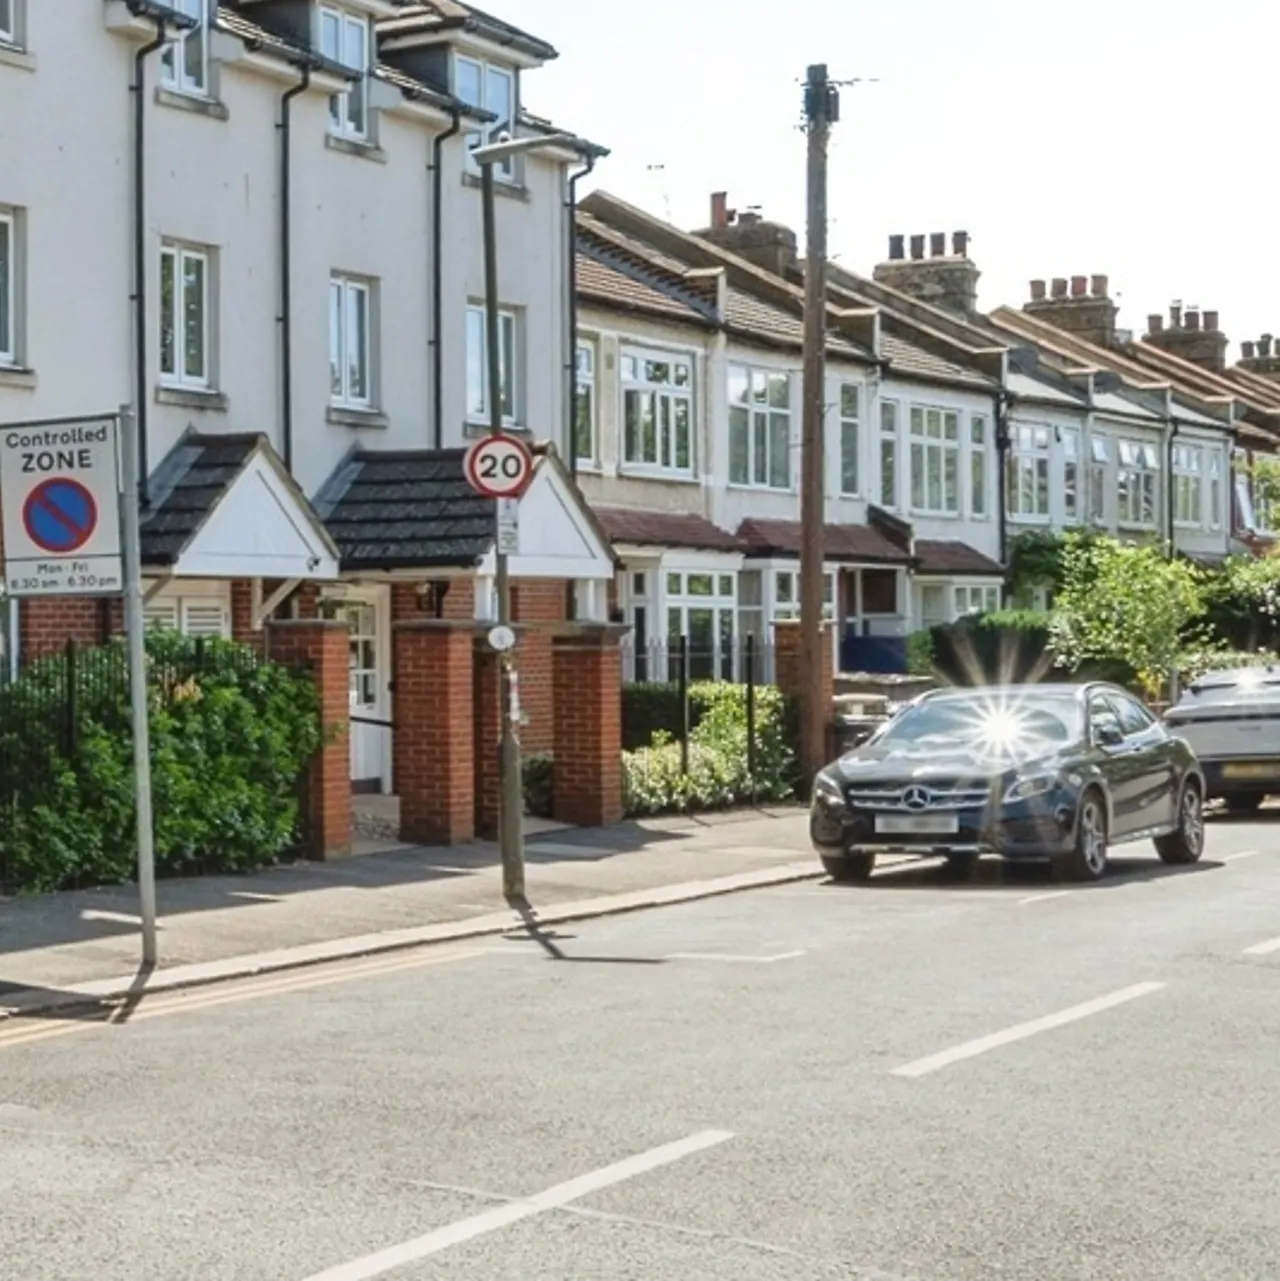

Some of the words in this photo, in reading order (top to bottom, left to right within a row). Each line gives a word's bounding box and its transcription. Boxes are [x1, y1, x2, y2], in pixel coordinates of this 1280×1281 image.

[5, 425, 108, 449] Controlled
[21, 448, 92, 473] ZONE
[479, 454, 522, 478] 20
[37, 563, 62, 574] Mon
[72, 561, 88, 572] Fri
